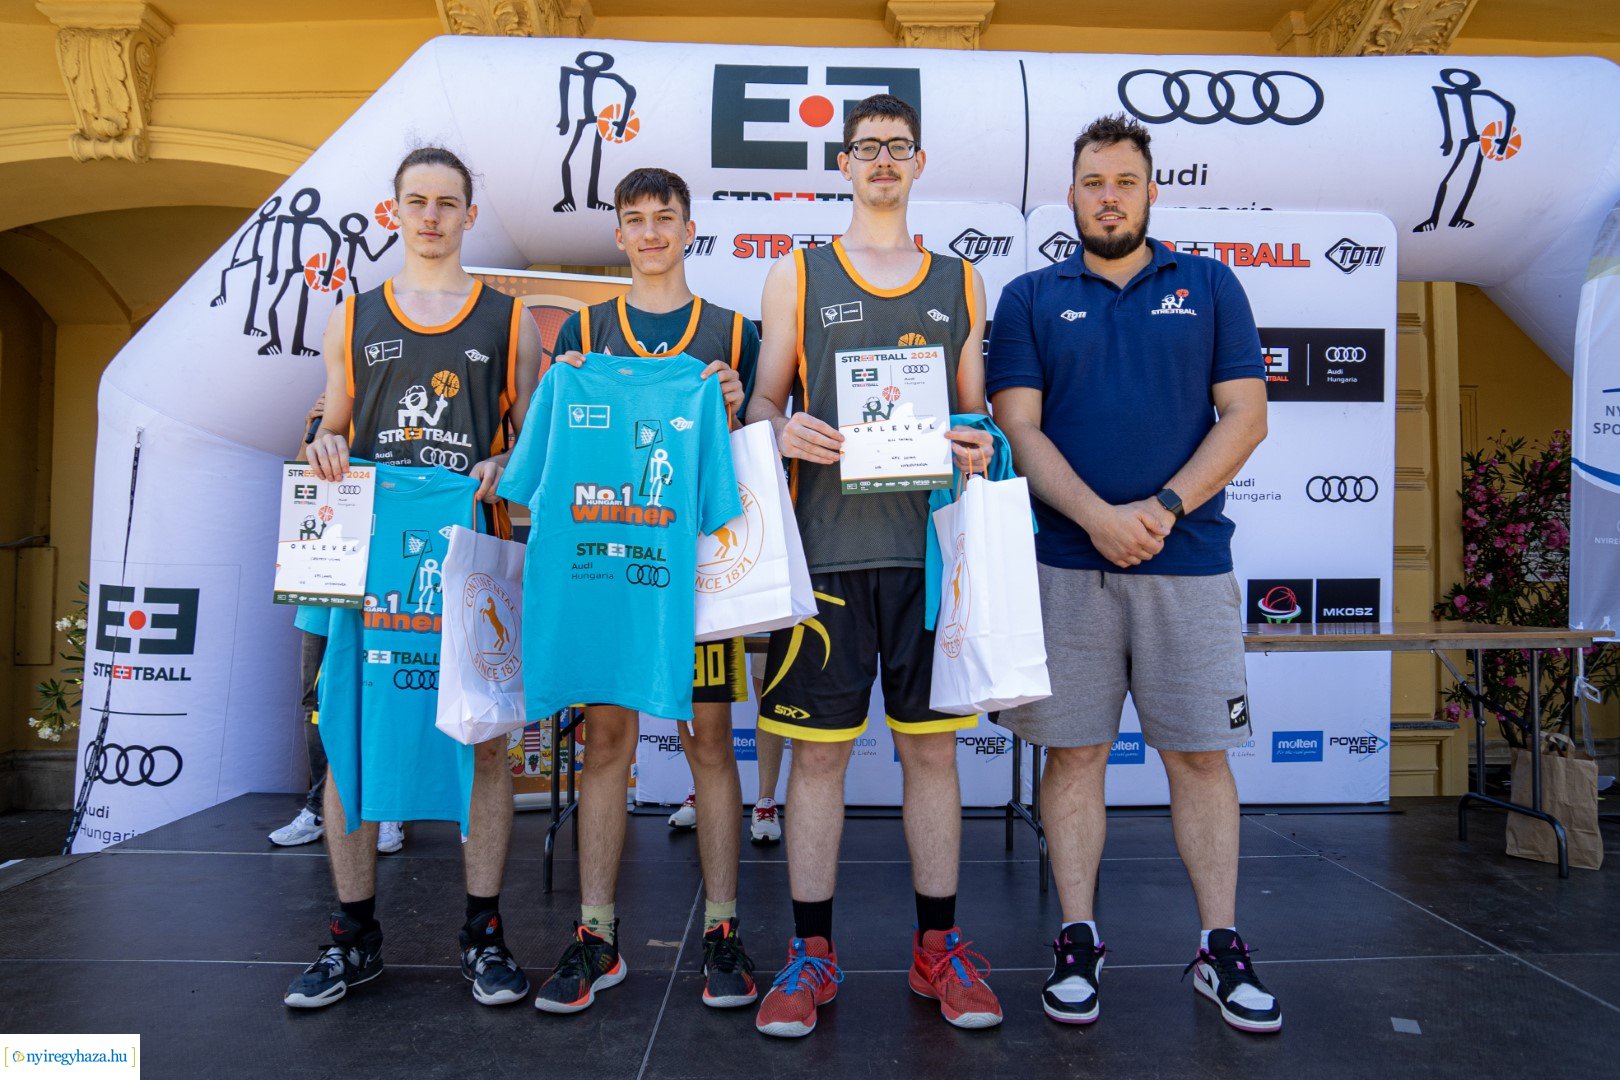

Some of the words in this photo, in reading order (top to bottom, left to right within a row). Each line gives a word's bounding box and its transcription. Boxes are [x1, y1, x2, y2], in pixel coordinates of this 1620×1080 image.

[1155, 163, 1208, 186] udi
[963, 236, 1014, 257] TOTI
[1339, 246, 1386, 266] TOTI
[841, 353, 907, 363] STREETBALL
[911, 351, 938, 360] 2024
[378, 427, 472, 447] STREETBALL
[375, 450, 393, 459] Audi
[346, 471, 371, 479] 2024
[1226, 491, 1282, 503] Hungaria
[571, 562, 593, 570] Audi
[695, 576, 722, 590] NCE
[725, 556, 753, 584] 1871
[1323, 607, 1374, 617] MKOSZ
[93, 662, 191, 681] STREETBALL
[473, 653, 499, 680] SINCE
[501, 655, 520, 677] 1871
[734, 736, 756, 747] lten
[853, 738, 877, 747] UDIO
[956, 737, 1007, 746] POWER
[1278, 739, 1318, 749] molten
[1330, 736, 1378, 746] POWER
[976, 745, 1004, 755] ADE
[1349, 745, 1376, 754] ADE
